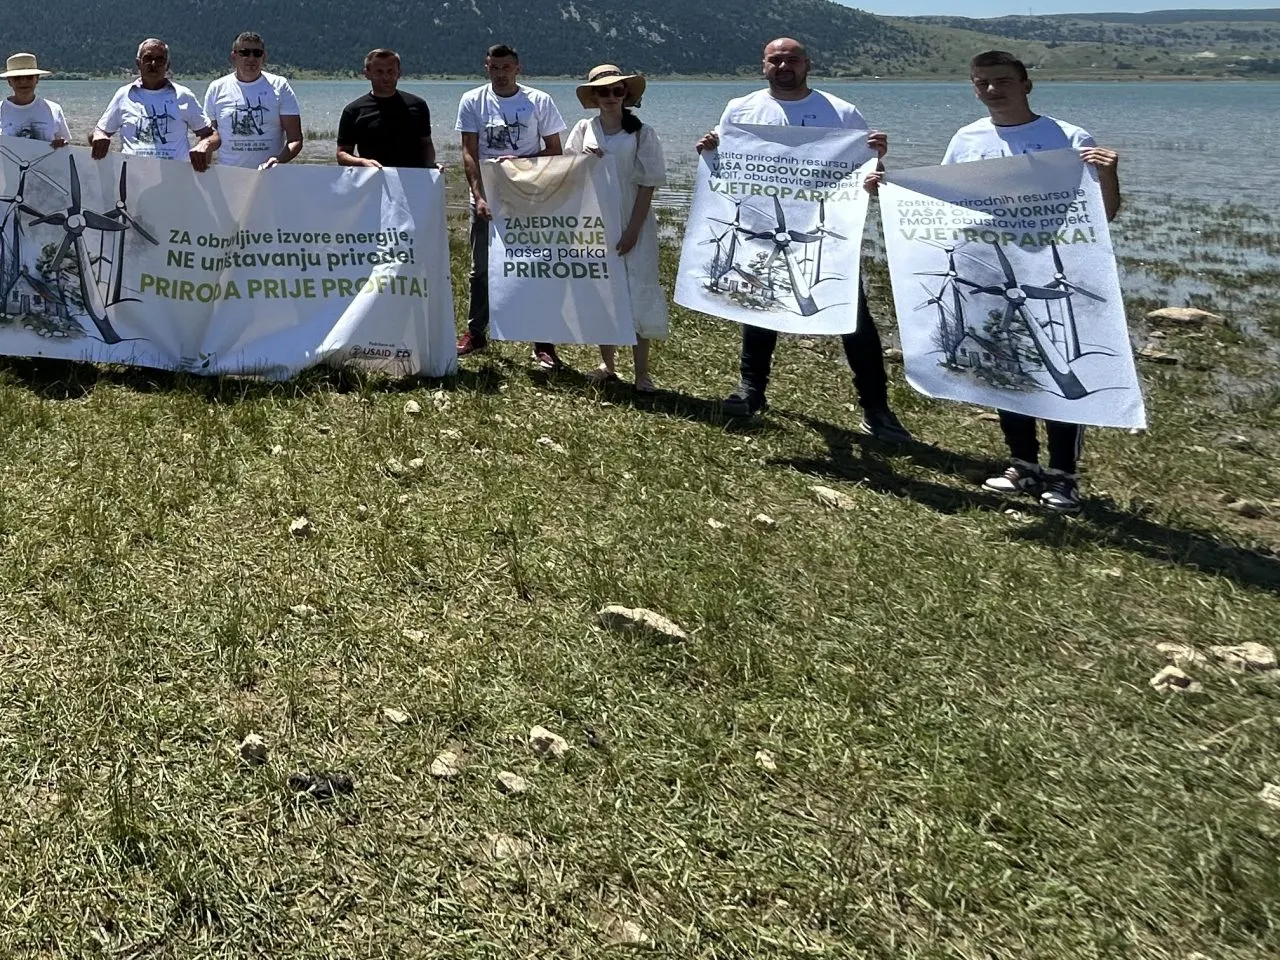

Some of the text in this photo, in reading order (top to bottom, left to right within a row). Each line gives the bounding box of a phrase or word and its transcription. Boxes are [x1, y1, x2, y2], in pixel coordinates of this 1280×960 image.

[746, 152, 799, 165] prirodnih
[802, 159, 848, 169] resursa
[851, 160, 862, 171] je
[745, 163, 862, 181] ODGOVORNOST
[744, 172, 812, 187] obustavite
[815, 179, 860, 191] projekt
[707, 179, 860, 203] VJETROPARKA!
[1018, 190, 1070, 203] resursa
[1071, 187, 1086, 201] je
[898, 207, 947, 217] VAŠA
[504, 216, 605, 229] ZAJEDNO ZA
[899, 214, 1091, 229] FMOIT, obustavite projekt
[169, 229, 192, 245] ZA
[277, 228, 332, 244] izvore
[335, 227, 413, 246] energije,
[503, 227, 605, 245] OČUVANJE
[167, 249, 195, 268] NE
[327, 248, 415, 271] prirode!
[505, 246, 606, 261] našeg parka
[503, 261, 609, 279] PRIRODE!
[247, 278, 317, 299] PRIJE
[322, 275, 428, 298] PROFITA!
[362, 347, 391, 358] USAID
